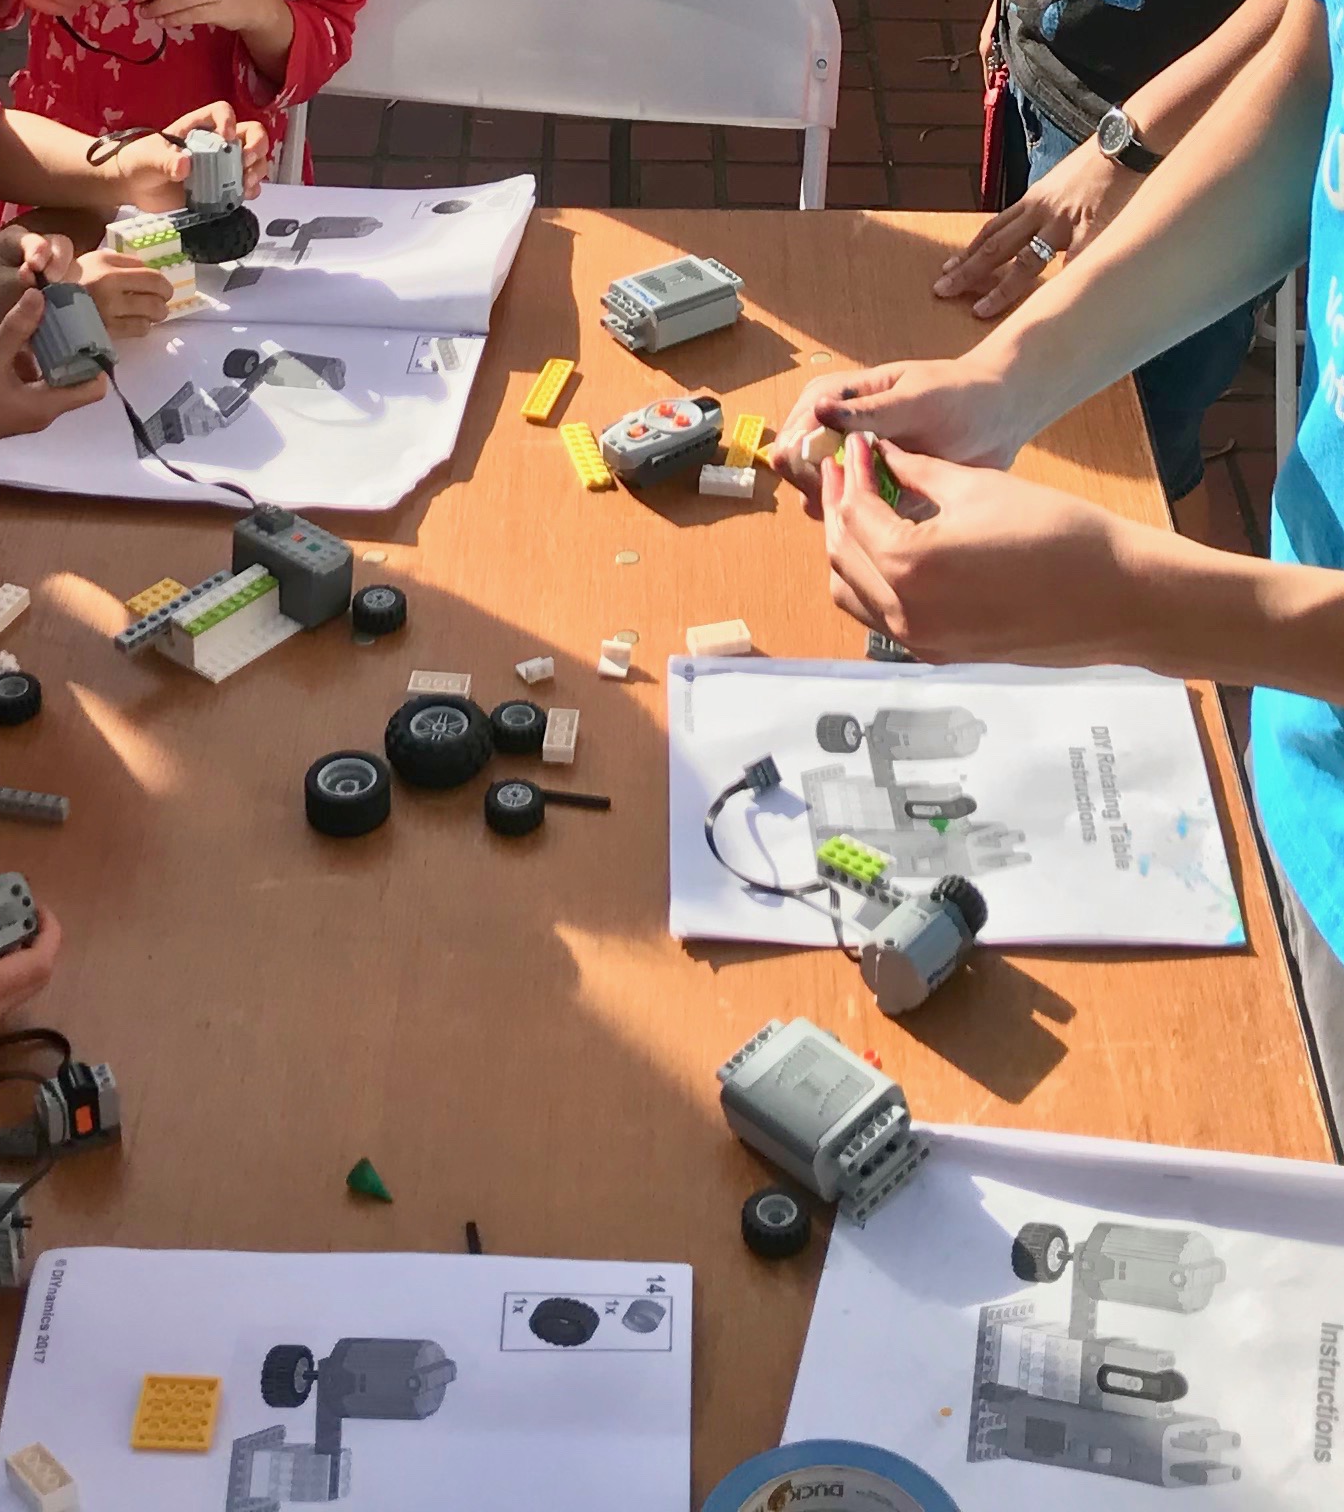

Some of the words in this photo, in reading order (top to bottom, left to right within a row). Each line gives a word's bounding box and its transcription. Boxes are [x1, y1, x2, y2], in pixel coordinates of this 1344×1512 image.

[1090, 725, 1115, 752] DIY
[1068, 745, 1098, 844] Instructions
[1096, 752, 1122, 819] Rotating
[1109, 823, 1133, 870] Table
[39, 1268, 65, 1332] DIYnamics
[645, 1273, 667, 1296] 14
[512, 1296, 528, 1315] 1x
[604, 1298, 620, 1316] 1x
[33, 1333, 51, 1365] 2017
[1313, 1321, 1344, 1465] Instructions
